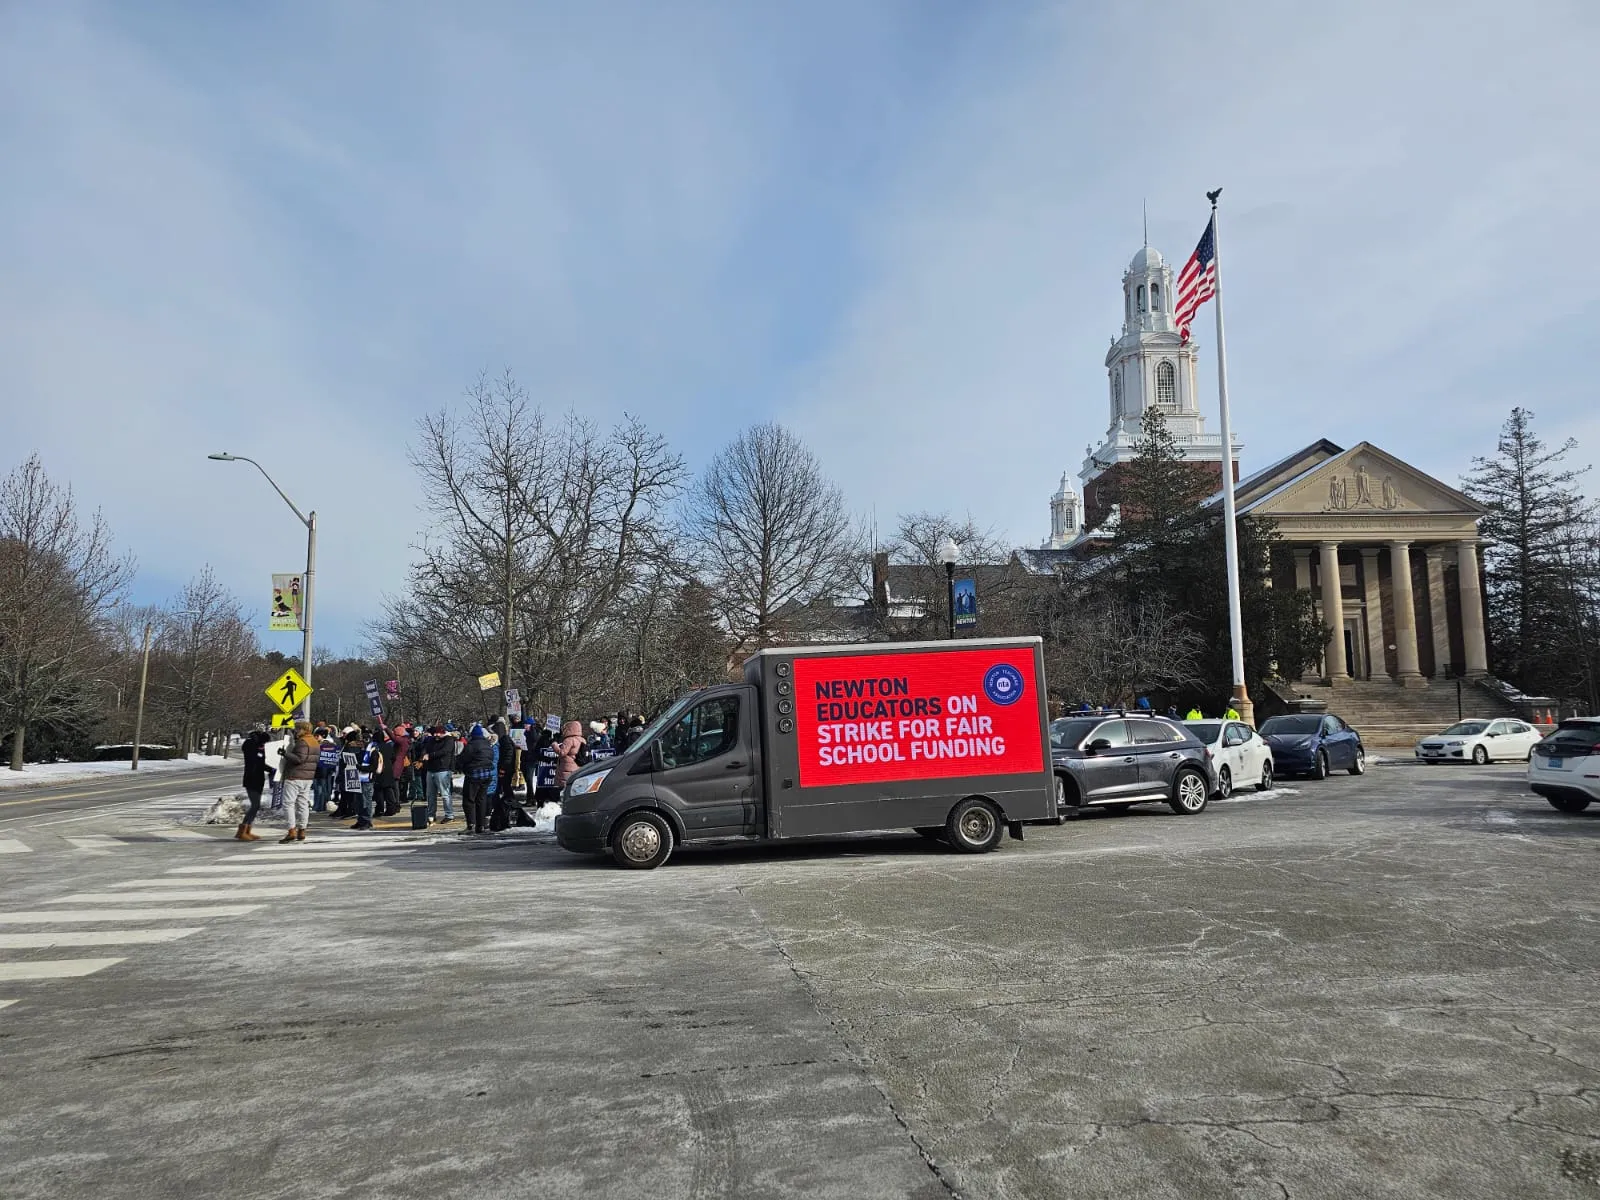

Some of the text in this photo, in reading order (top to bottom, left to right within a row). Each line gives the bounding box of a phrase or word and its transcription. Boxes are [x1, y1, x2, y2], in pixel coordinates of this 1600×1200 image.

[815, 677, 908, 700] NEWTON
[816, 694, 977, 722] EDUCATORS ON
[817, 715, 993, 744] STRIKE FOR FAIR
[819, 736, 1005, 767] SCHOOL FUNDING
